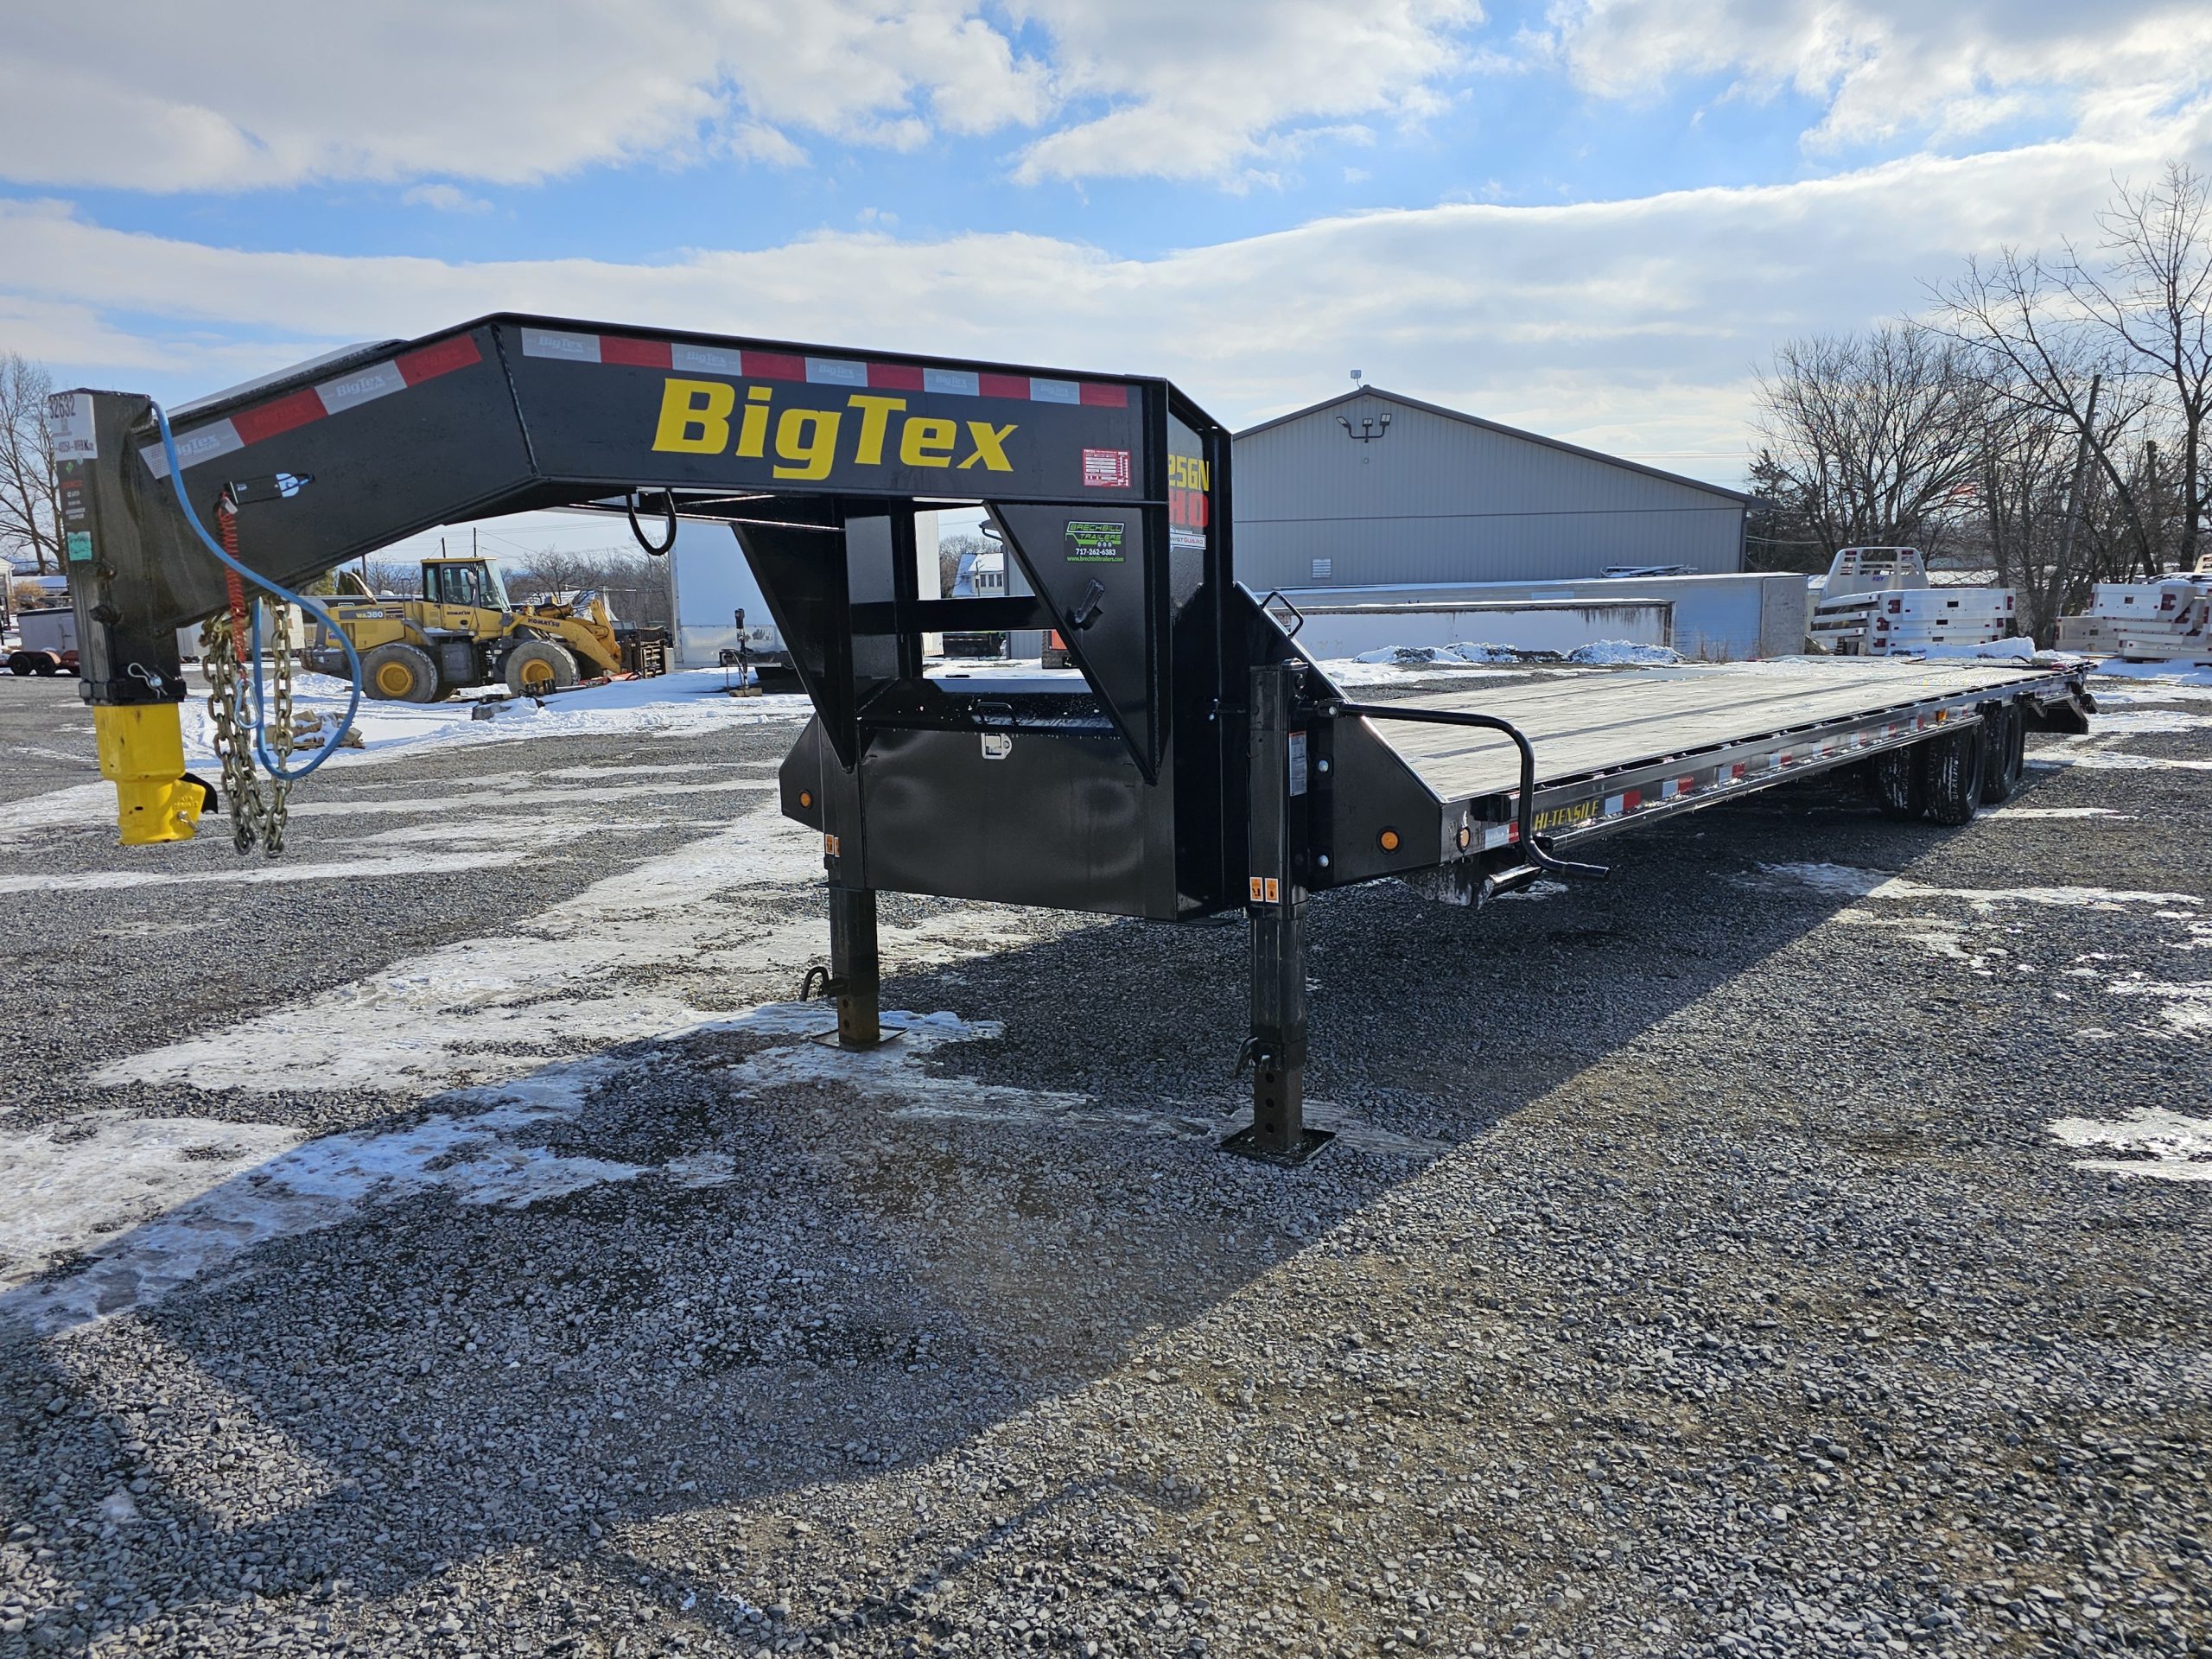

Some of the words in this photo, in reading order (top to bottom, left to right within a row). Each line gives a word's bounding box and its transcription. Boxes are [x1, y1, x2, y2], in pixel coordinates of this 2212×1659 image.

[336, 373, 385, 397] BigTex
[651, 378, 1019, 480] BigTex
[175, 434, 218, 457] igTex
[1169, 488, 1209, 528] HD
[1070, 524, 1121, 532] BRECHBILL
[527, 617, 561, 628] KOMATSU
[1534, 799, 1599, 831] HI-TENSILE
